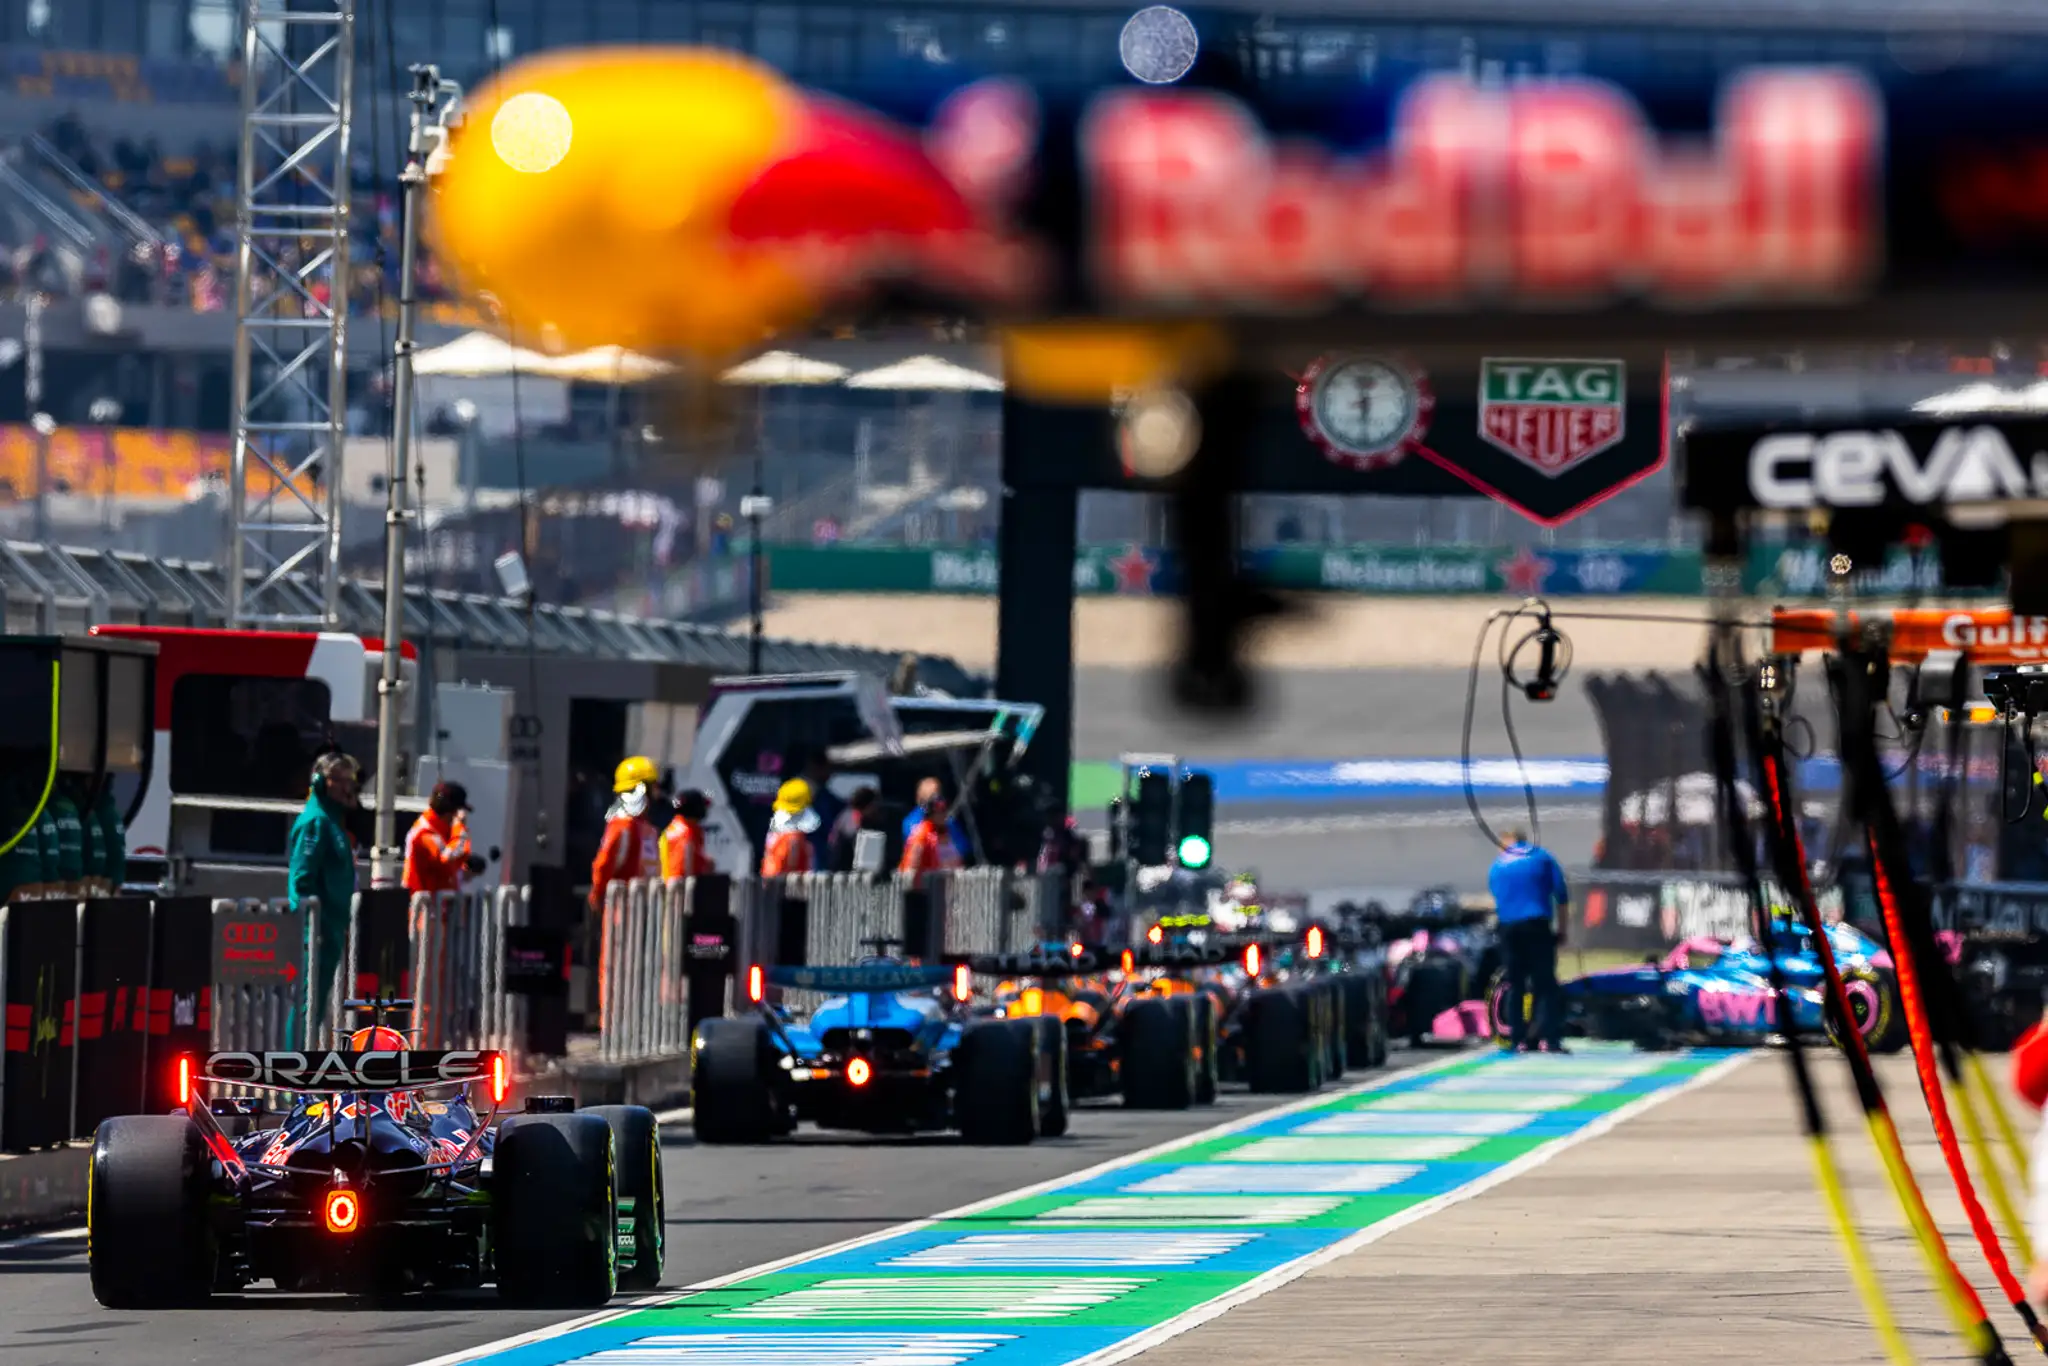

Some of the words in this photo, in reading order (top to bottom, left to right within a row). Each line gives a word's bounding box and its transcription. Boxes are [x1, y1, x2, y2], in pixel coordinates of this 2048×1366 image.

[1495, 366, 1613, 399] TAG
[1488, 406, 1622, 467] HEUER
[1942, 613, 2048, 648] Gulf
[204, 1050, 482, 1085] ORACLE
